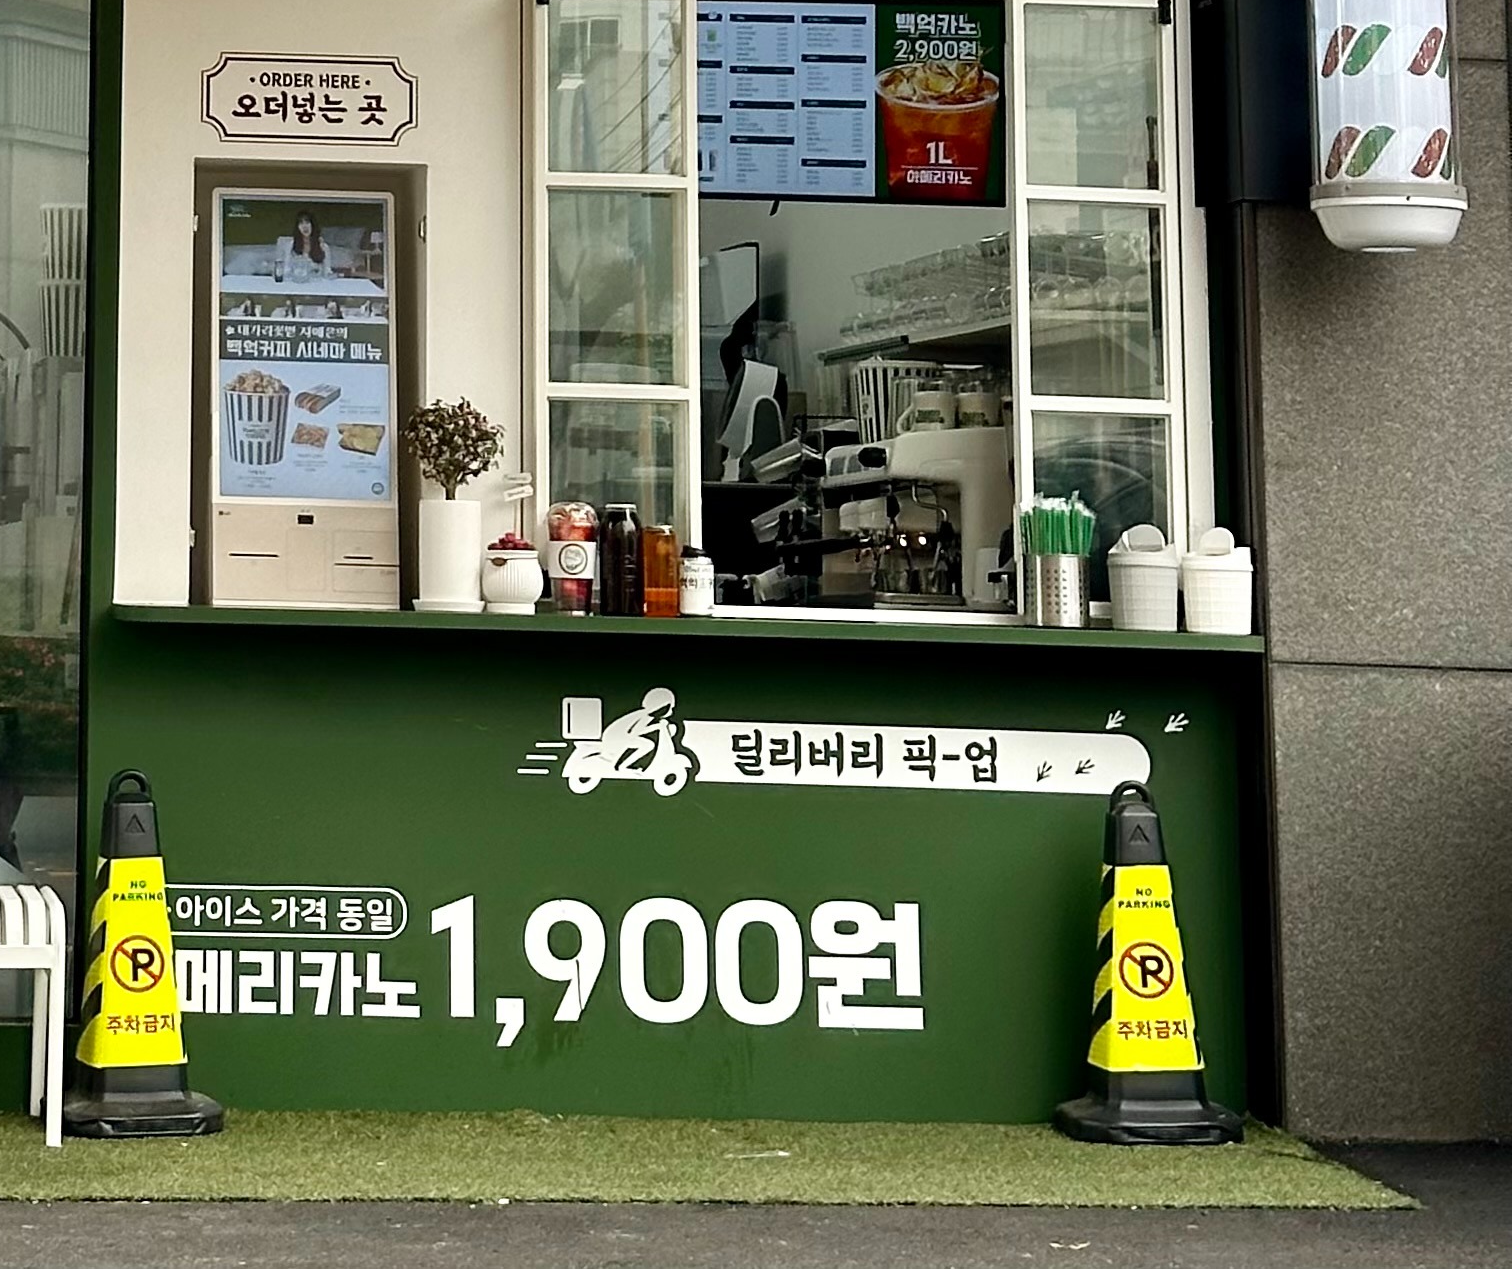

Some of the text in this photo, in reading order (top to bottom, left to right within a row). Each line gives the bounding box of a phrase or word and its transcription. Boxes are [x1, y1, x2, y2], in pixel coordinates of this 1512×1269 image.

[895, 12, 979, 36] 백억카노
[894, 38, 978, 61] 2,900원
[259, 72, 361, 89] ORDER HERE
[231, 91, 388, 125] 오더넣는 곳
[926, 141, 953, 165] 1L
[906, 169, 973, 185] 아메리카노
[731, 728, 998, 783] 딜리버리 픽-업
[129, 880, 147, 889] NO
[1135, 888, 1153, 896] NO
[112, 892, 164, 902] PARKING
[1117, 899, 1171, 909] PARKING
[270, 896, 327, 931] 가격
[336, 897, 394, 932] 동일
[430, 893, 925, 1048] 1,900원
[106, 1013, 176, 1035] 주차금지
[1116, 1019, 1189, 1040] 주차금지
